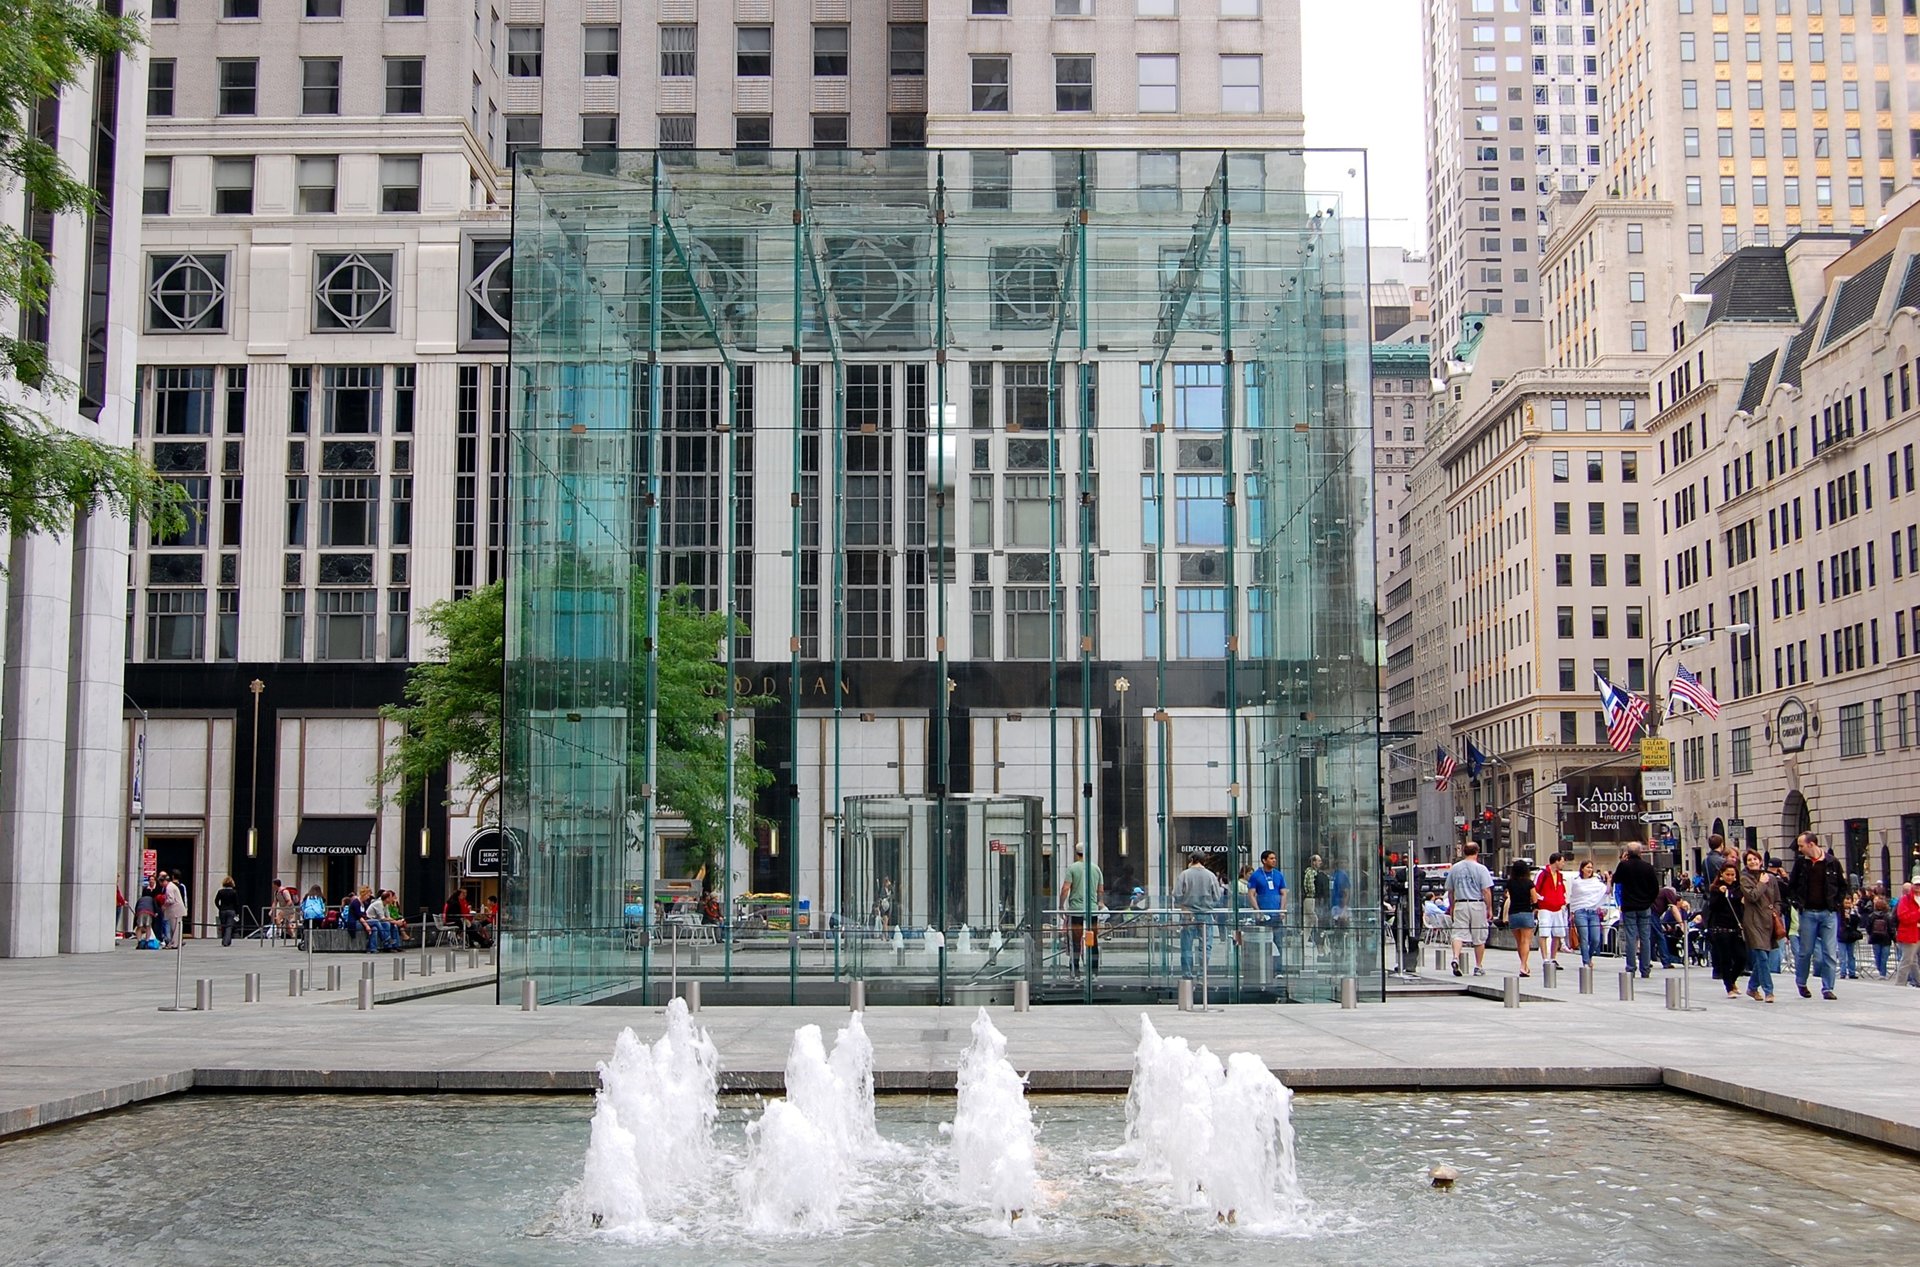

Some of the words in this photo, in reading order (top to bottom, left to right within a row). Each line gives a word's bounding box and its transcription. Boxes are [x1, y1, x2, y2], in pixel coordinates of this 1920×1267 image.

[1590, 785, 1633, 802] Anish
[1576, 797, 1636, 819] Kapoor
[1604, 813, 1638, 822] interprets
[296, 846, 328, 854] BERGDORF
[328, 846, 362, 854] GOODMAN
